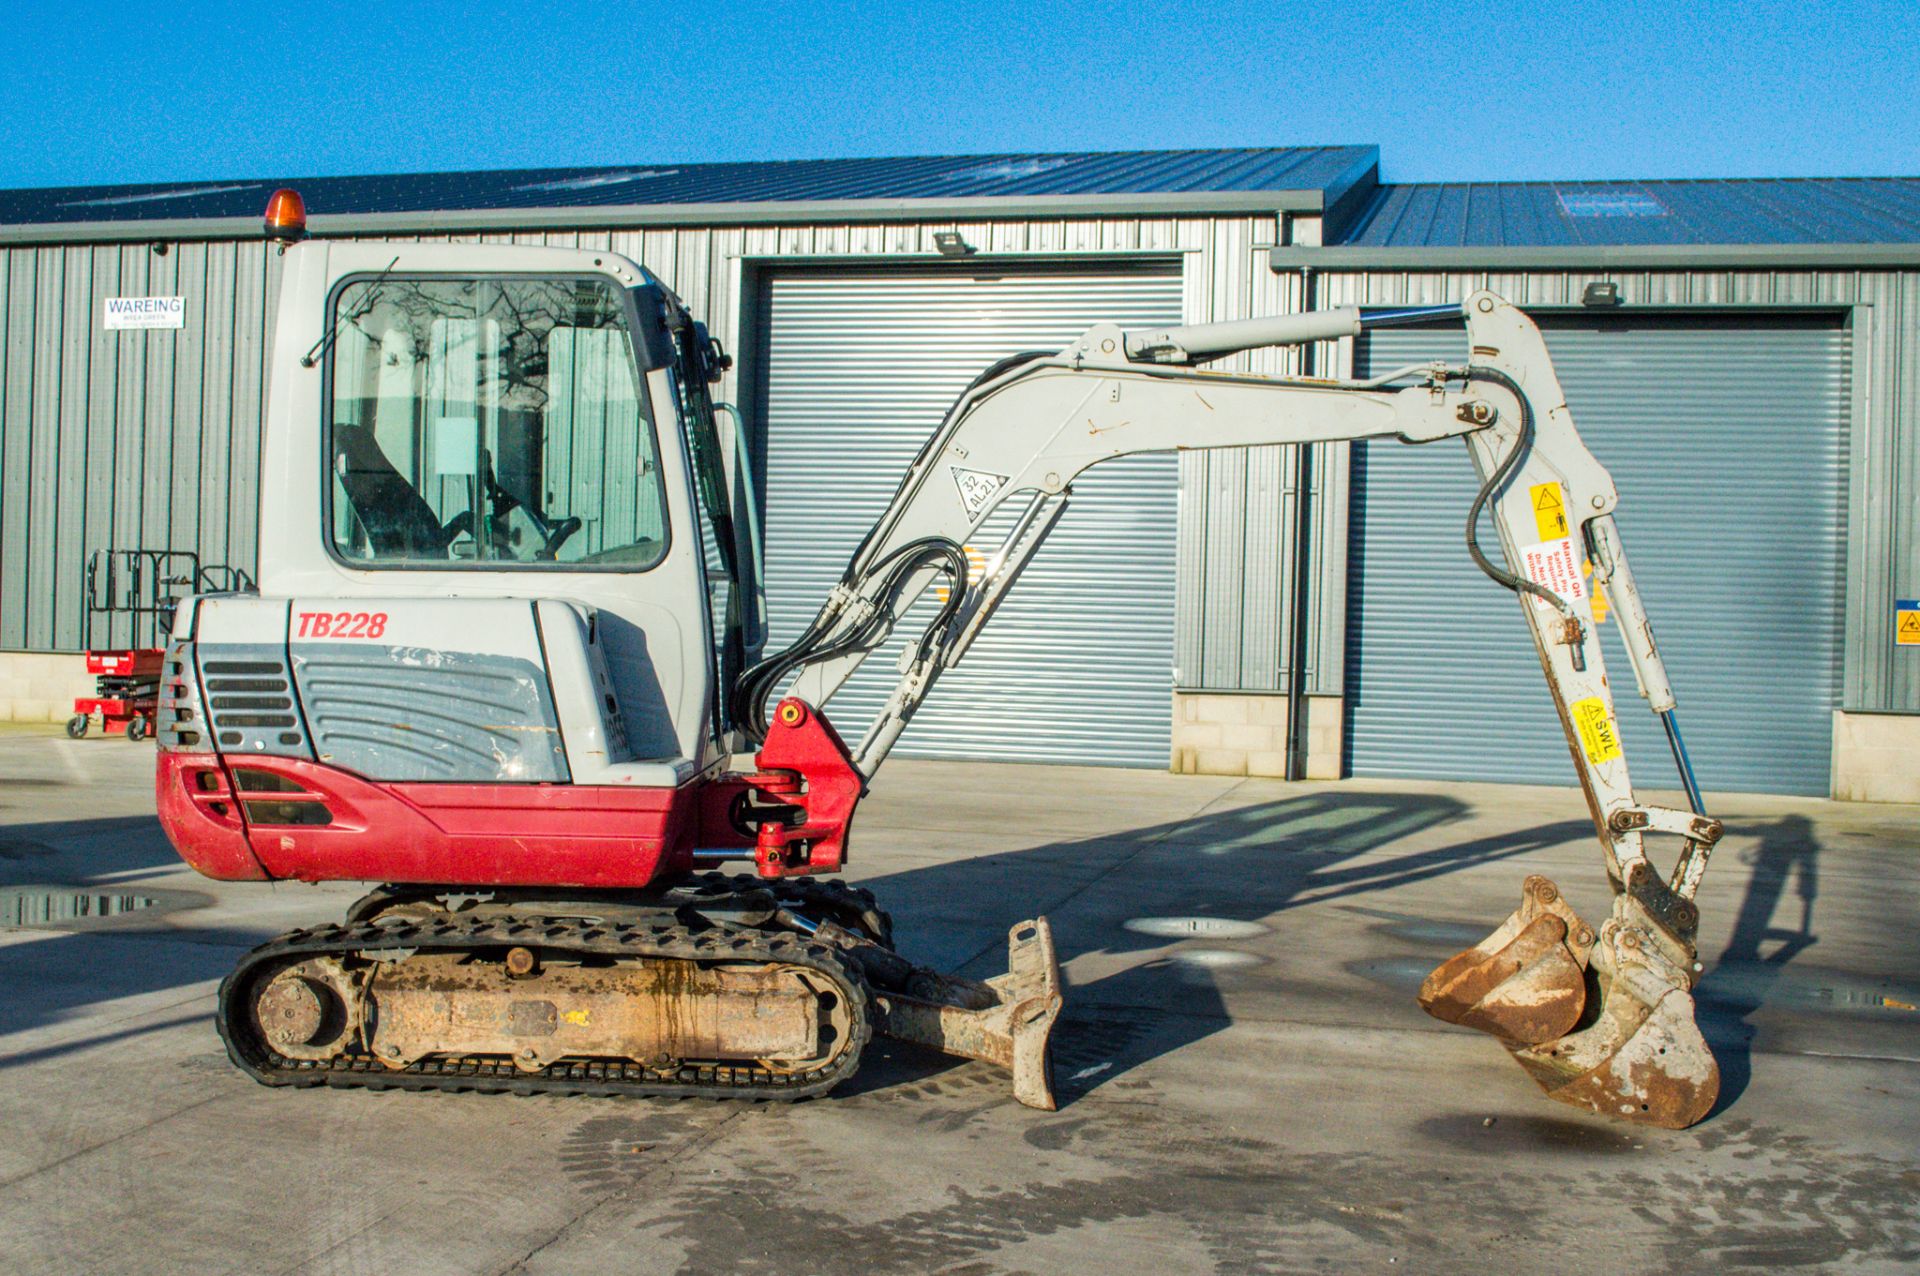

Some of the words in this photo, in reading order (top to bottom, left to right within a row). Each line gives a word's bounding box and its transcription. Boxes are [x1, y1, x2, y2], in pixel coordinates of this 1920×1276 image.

[109, 299, 180, 313] WAREING
[963, 476, 979, 492] 32
[1538, 567, 1546, 581] Not
[1546, 555, 1560, 592] Required
[1553, 551, 1563, 577] Safety
[1561, 541, 1578, 579] Manual
[1571, 582, 1582, 598] QH
[298, 612, 388, 638] TB228
[1595, 720, 1613, 754] SWL
